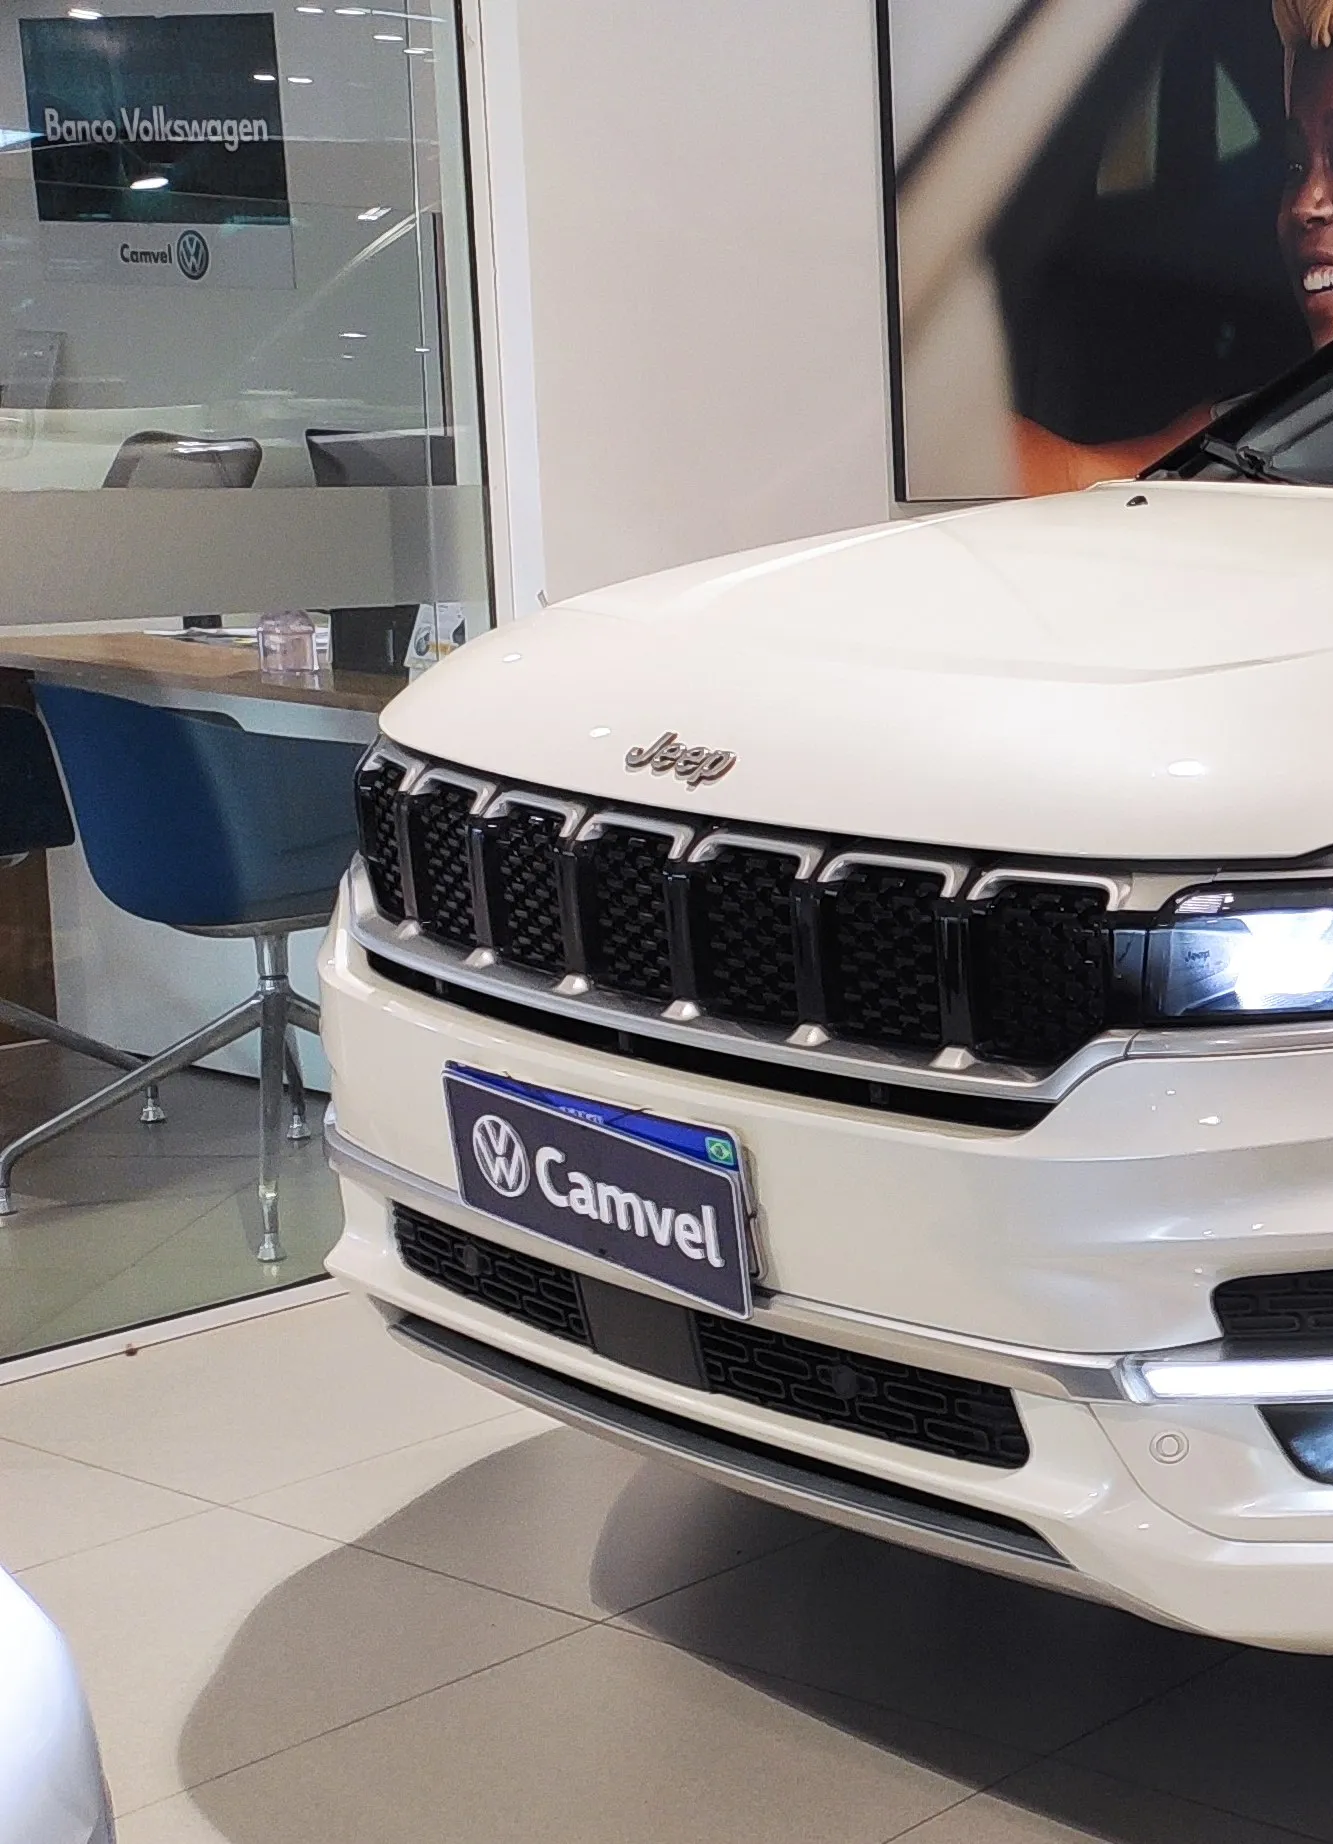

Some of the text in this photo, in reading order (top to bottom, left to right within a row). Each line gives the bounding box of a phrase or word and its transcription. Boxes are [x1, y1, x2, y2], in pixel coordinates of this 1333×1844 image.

[43, 105, 269, 152] Banco Volkswagen
[120, 243, 173, 264] Camvel
[624, 731, 738, 790] Jeep
[535, 1146, 726, 1269] Camvel
